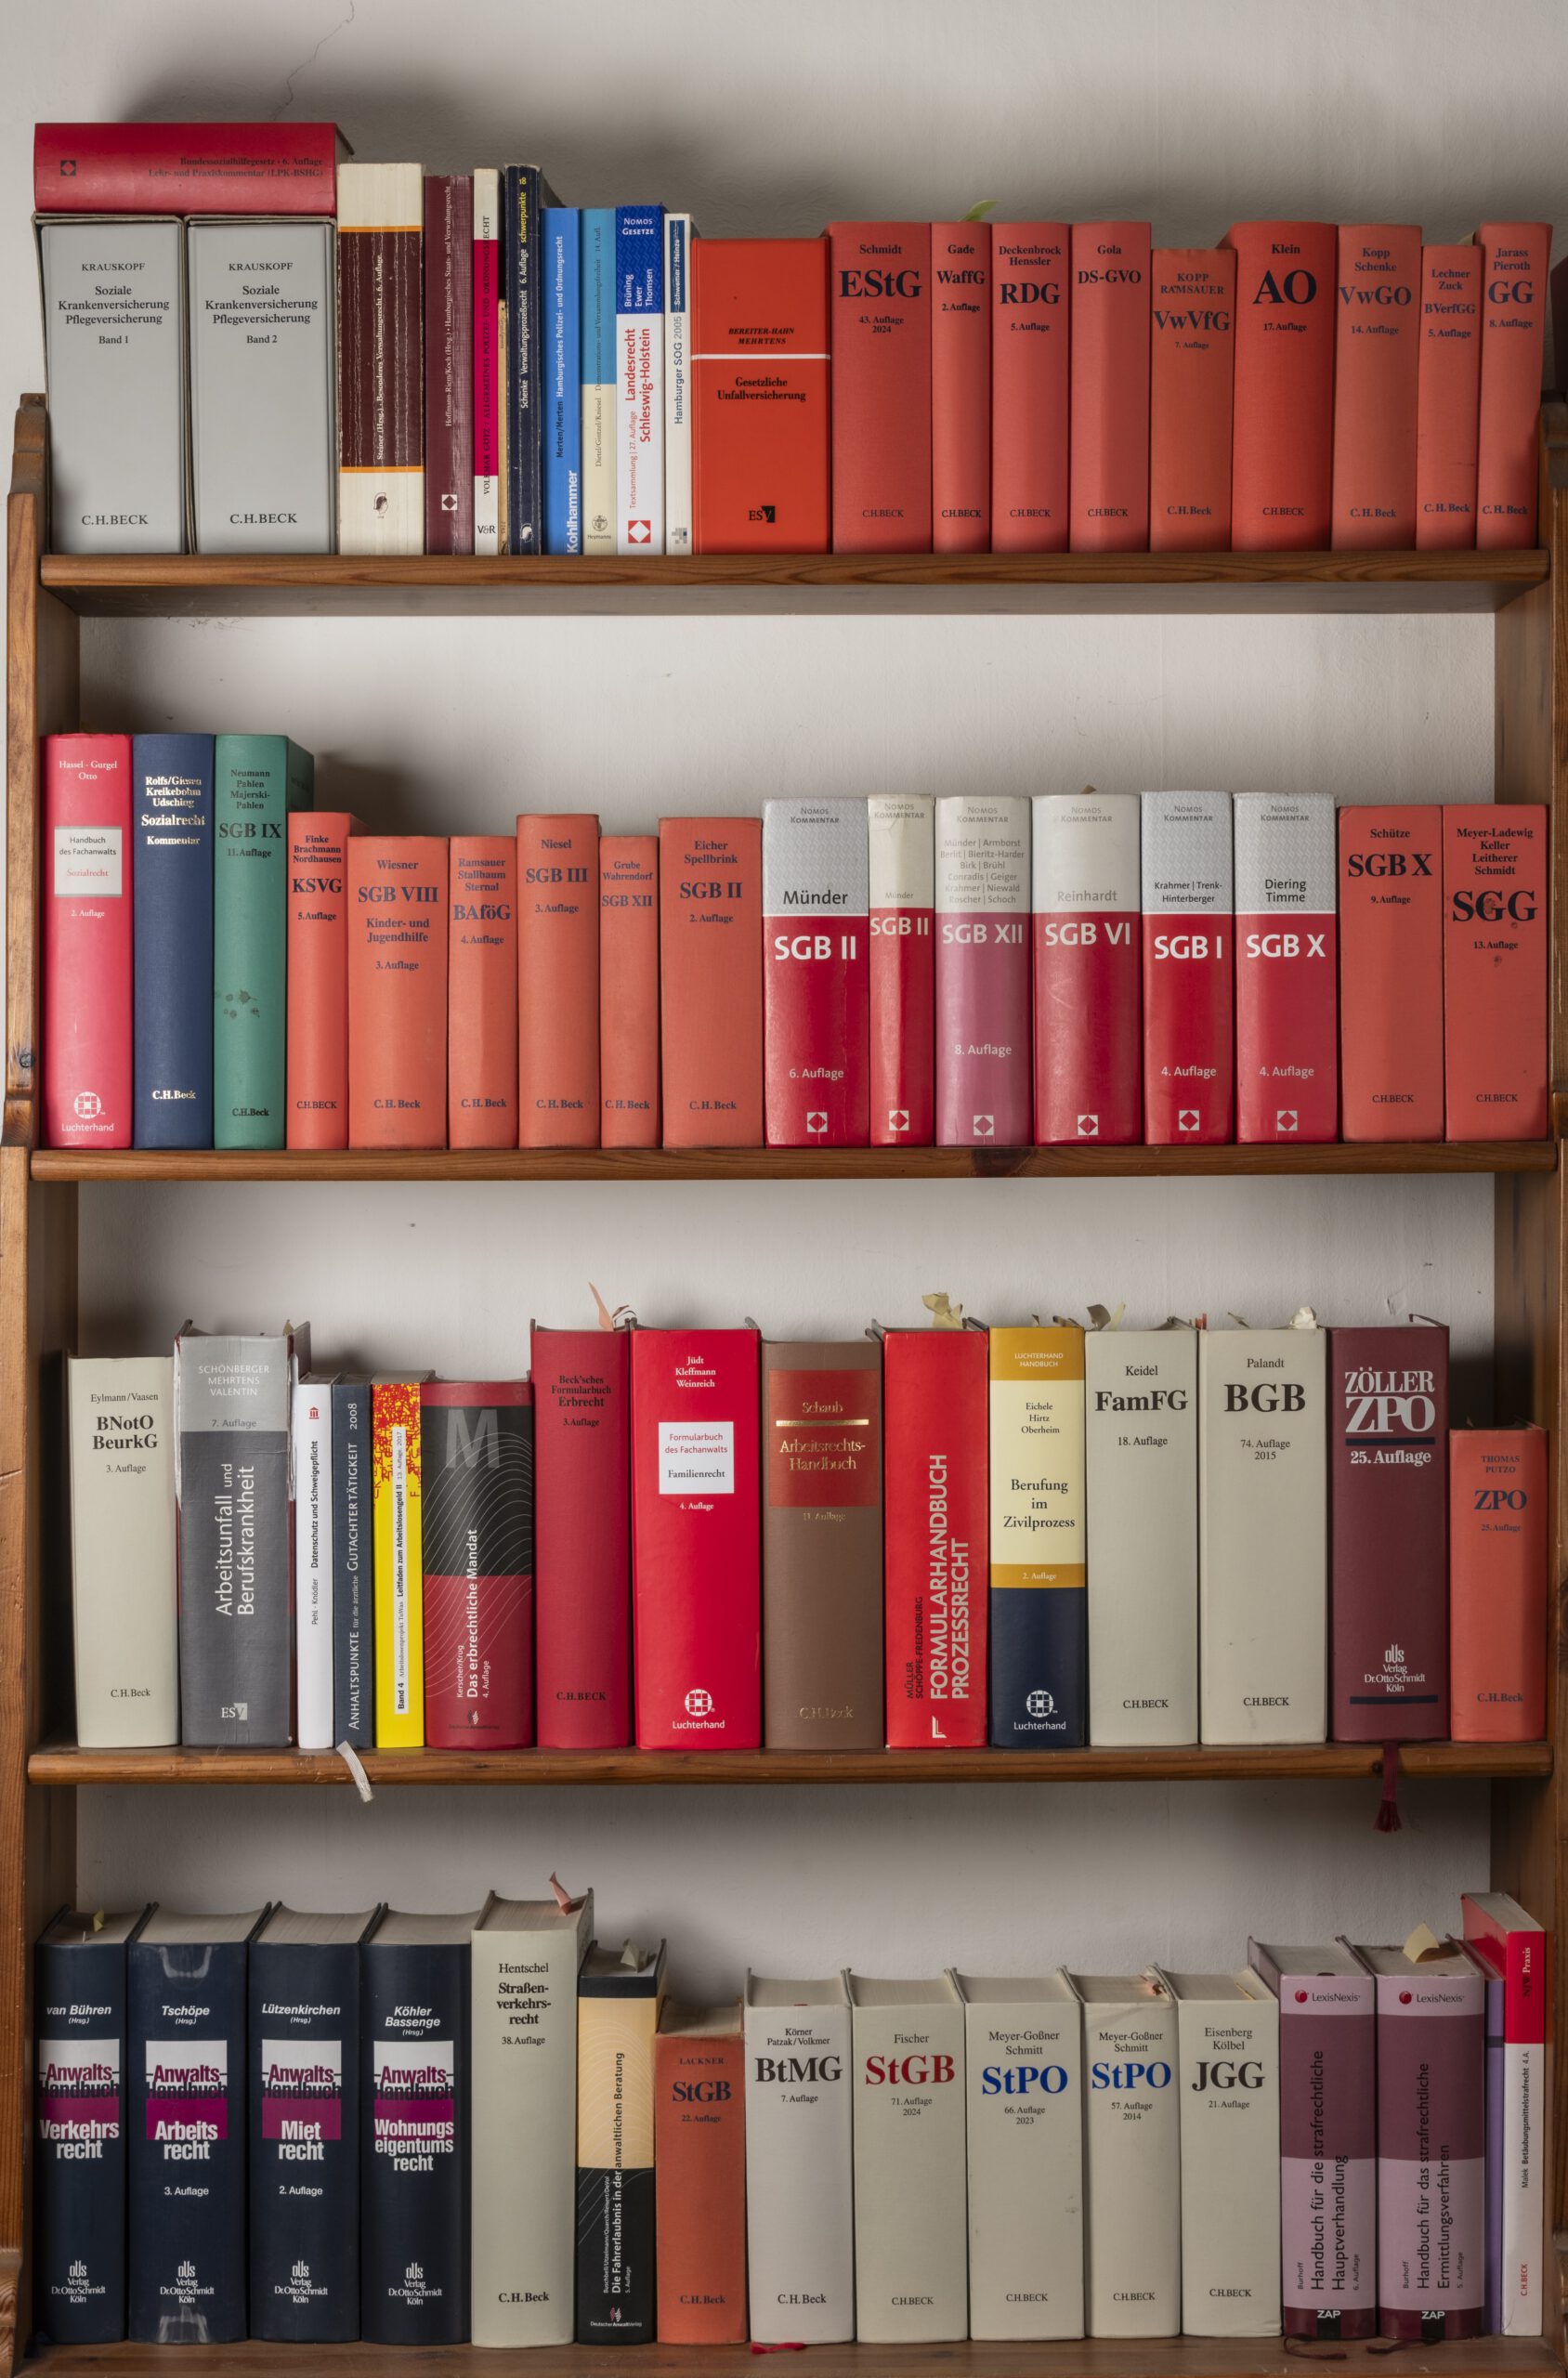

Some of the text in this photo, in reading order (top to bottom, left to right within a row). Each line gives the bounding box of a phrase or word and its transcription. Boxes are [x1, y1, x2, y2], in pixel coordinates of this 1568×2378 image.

[294, 158, 322, 168] Auflage
[518, 192, 528, 242] schwerpunkte
[860, 244, 901, 254] Schmidt
[1000, 245, 1061, 255] Deckenbrock
[1097, 245, 1121, 254] Gola
[83, 263, 144, 271] KRAUSKOPF
[1355, 262, 1397, 271] Schenke
[1494, 261, 1530, 270] Pieroth
[937, 270, 985, 283] WaffG
[1078, 270, 1141, 283] DS-GVO
[1432, 268, 1470, 278] Lechner
[841, 270, 921, 297] EStG
[1254, 270, 1316, 304] AO
[96, 286, 132, 295] Soziale
[624, 274, 634, 307] Brüning
[1001, 283, 1060, 304] RDG
[1339, 286, 1411, 305] VwGO
[1489, 281, 1533, 303] GG
[59, 300, 169, 310] Krankenversicherung
[1426, 304, 1475, 313] BVerfGG
[67, 314, 162, 326] Pflegeversicherung
[859, 316, 904, 325] 43. Auflage
[1155, 311, 1229, 331] VwVfG
[556, 336, 565, 397] Hamburgisches
[624, 329, 635, 400] Landesrecht
[673, 317, 684, 424] Hamburger SOG 2005
[639, 329, 653, 442] Schleswig-Holstein
[736, 377, 788, 386] Gesetzliche
[717, 390, 805, 401] Unfallversicherung
[567, 470, 577, 554] Kohlhammer
[750, 505, 775, 523] ESV
[942, 509, 981, 517] C.H.BECK
[82, 515, 148, 525] C.H.BECK
[477, 525, 495, 534] V&R
[153, 798, 194, 808] Udsching
[141, 815, 204, 826] Sozialrecht
[220, 823, 281, 838] SGB IX
[1370, 829, 1410, 838] Schütze
[1457, 828, 1533, 839] Meyer-Ladewig
[147, 836, 200, 844] Kommentar
[542, 840, 571, 848] Niesel
[377, 860, 419, 869] Wiesner
[459, 858, 505, 867] Ramsauer
[685, 855, 738, 866] Spellbrink
[1472, 854, 1518, 862] Leitherer
[1349, 854, 1431, 877] SGB X
[527, 869, 587, 882] SGB III
[294, 879, 342, 893] KSVG
[680, 882, 741, 898] SGB II
[1265, 879, 1306, 892] Diering
[359, 886, 438, 902] SGB VIII
[784, 890, 847, 904] Münder
[1058, 890, 1117, 901] Reinhardt
[1163, 895, 1214, 904] Hinterberger
[1453, 891, 1535, 921] SGG
[455, 905, 511, 921] BAföG
[367, 918, 429, 928] Kinder- und
[368, 933, 428, 944] Jugendhilfe
[1046, 923, 1130, 946] SGB VI
[775, 936, 856, 960] SGB II
[1247, 934, 1326, 958] SGB X
[790, 1068, 843, 1080] 6. Auflage
[62, 1123, 114, 1131] Luchterhand
[1248, 1358, 1284, 1367] Palandt
[199, 1365, 269, 1374] SCHÖNBERGER
[1126, 1365, 1157, 1376] Keidel
[1345, 1367, 1434, 1393] ZÖLLER
[1095, 1391, 1188, 1411] FamFG
[1224, 1384, 1305, 1412] BGB
[1346, 1395, 1435, 1432] ZPO
[98, 1416, 153, 1430] BNotO
[93, 1434, 157, 1449] BeurkG
[1351, 1450, 1431, 1467] 25. Auflage
[310, 1442, 320, 1501] Schweigepflicht
[669, 1469, 725, 1477] Familienrecht
[1012, 1479, 1068, 1494] Berufung
[1031, 1498, 1047, 1509] im
[1004, 1516, 1075, 1531] Zivilprozess
[237, 1466, 254, 1614] Berufskrankheit
[215, 1496, 232, 1615] Arbeitsunfall
[930, 1456, 947, 1699] FORMULARHANDBUCH
[466, 1530, 477, 1697] Das erbrechtliche Mandat
[951, 1538, 969, 1698] PROZESSRECHT
[348, 1632, 359, 1730] ANHALTSPUNKTE
[1244, 1697, 1289, 1705] C.H.BECK
[1014, 1721, 1065, 1730] Luchterhand
[499, 1963, 548, 1973] Hentschel
[499, 1983, 548, 1993] Straßen-
[497, 1998, 551, 2009] verkehrs-
[1313, 1993, 1358, 2002] LexisNexis
[70, 2006, 111, 2015] Bühren
[163, 2006, 210, 2017] Tschöpe
[262, 2004, 340, 2015] Lützenkirchen
[895, 2033, 929, 2044] Fischer
[989, 2031, 1060, 2043] Meyer-Goßner
[1205, 2028, 1252, 2039] Eisenberg
[1006, 2045, 1042, 2055] Schmitt
[1213, 2041, 1244, 2050] Kölbel
[755, 2057, 843, 2082] BtMG
[866, 2056, 955, 2084] StGB
[983, 2066, 1067, 2095] StPO
[1192, 2062, 1265, 2091] JGG
[673, 2081, 731, 2102] StGB
[1522, 2068, 1530, 2164] Betäubungsmittelstrafrecht
[40, 2120, 119, 2139] Verkehrs
[154, 2121, 218, 2140] Arbeits
[281, 2121, 320, 2140] Miet
[374, 2119, 453, 2138] Wohnungs
[57, 2138, 102, 2159] recht
[375, 2138, 453, 2156] eigentums
[1310, 2051, 1324, 2290] Handbuch für die strafrechtliche
[1332, 2156, 1349, 2290] Hauptverhandlung
[1438, 2146, 1452, 2288] Ermittlungsverfahren
